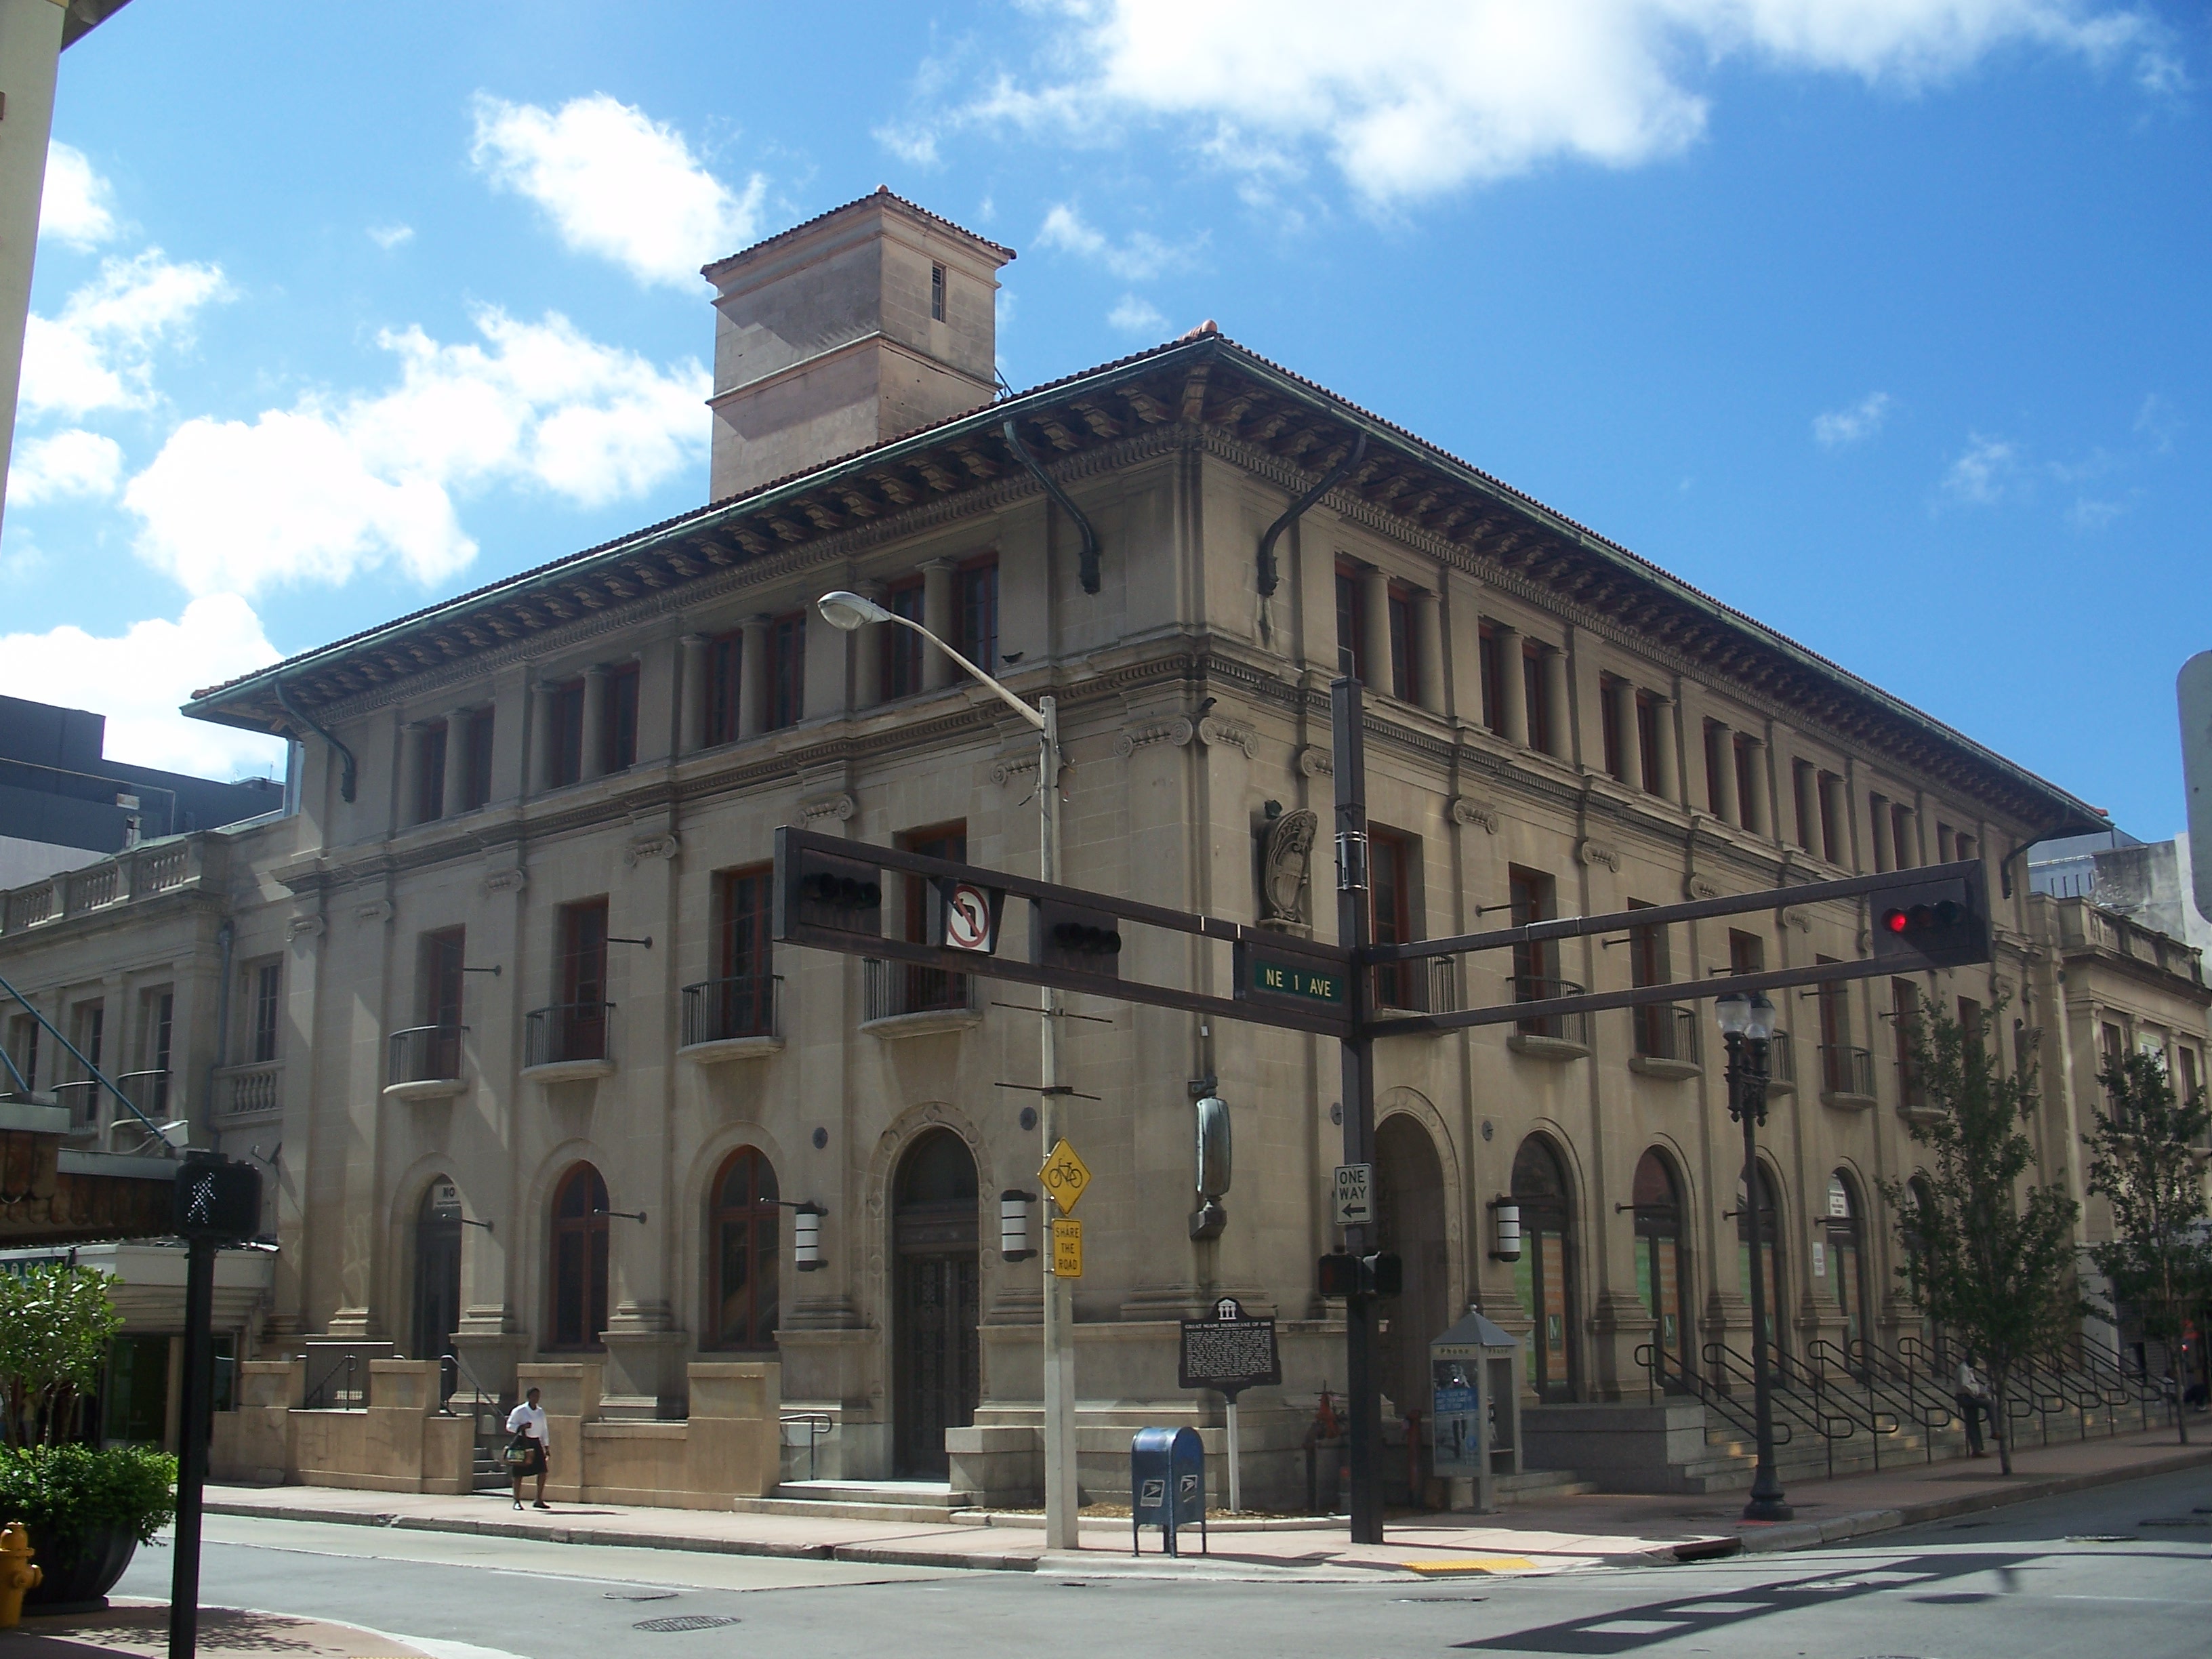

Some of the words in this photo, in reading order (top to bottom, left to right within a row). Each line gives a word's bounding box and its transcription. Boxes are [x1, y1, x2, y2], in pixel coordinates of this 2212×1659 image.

[1266, 968, 1284, 987] NE
[1294, 974, 1299, 991] 1
[1309, 978, 1332, 998] AVE
[1340, 1170, 1365, 1185] ONE
[443, 1186, 455, 1197] NO
[1339, 1186, 1367, 1200] WAY
[1056, 1227, 1080, 1238] SHARE
[1061, 1242, 1075, 1254] THE
[1059, 1258, 1078, 1270] ROAD
